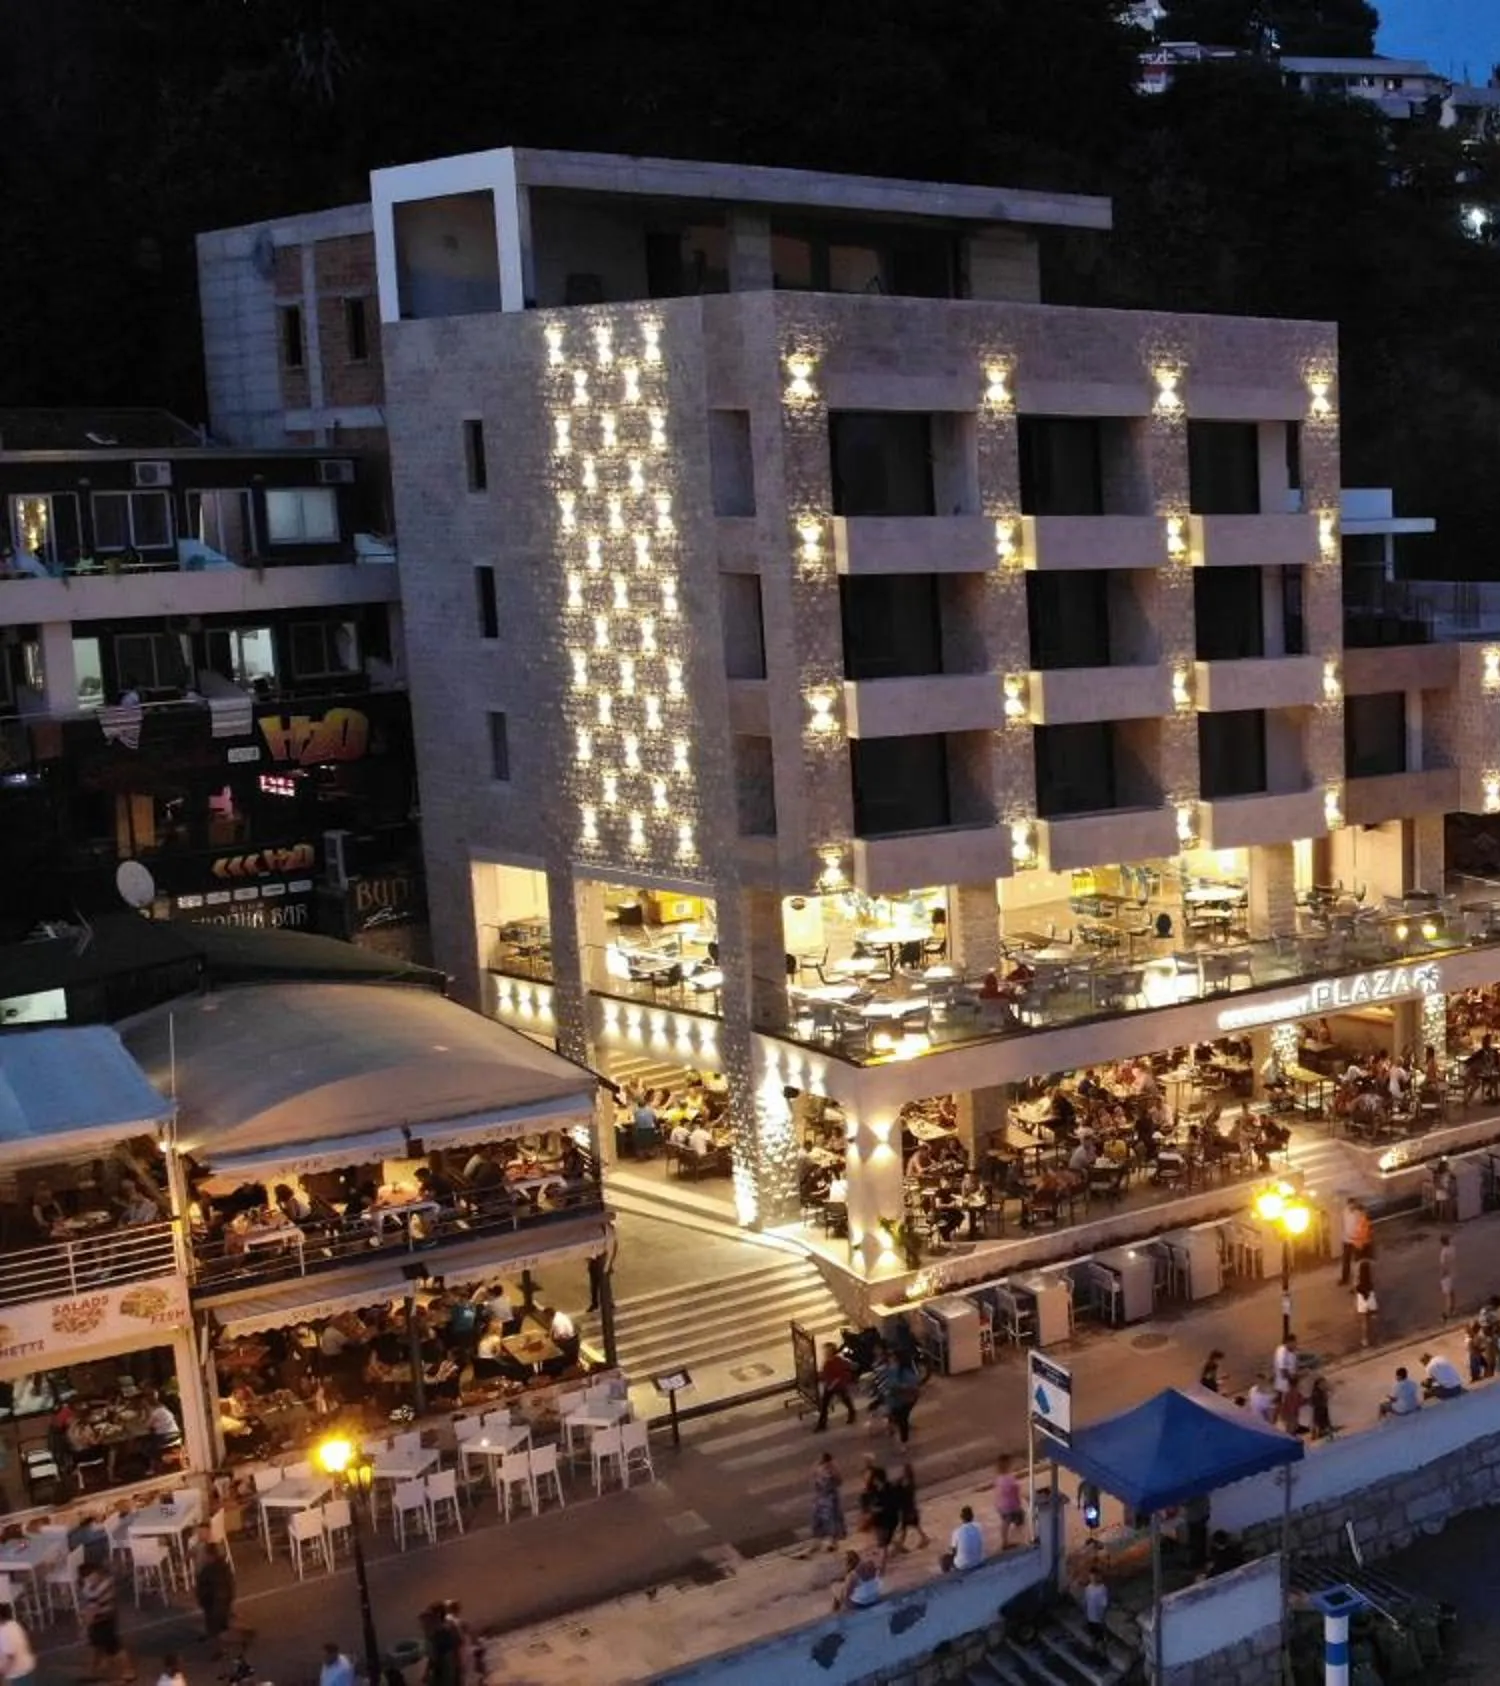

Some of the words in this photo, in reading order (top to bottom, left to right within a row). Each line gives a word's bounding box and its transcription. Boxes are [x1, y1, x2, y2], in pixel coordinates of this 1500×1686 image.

[1310, 967, 1411, 1010] PLAZA
[52, 1294, 109, 1317] SALADS
[151, 1309, 187, 1325] FISH
